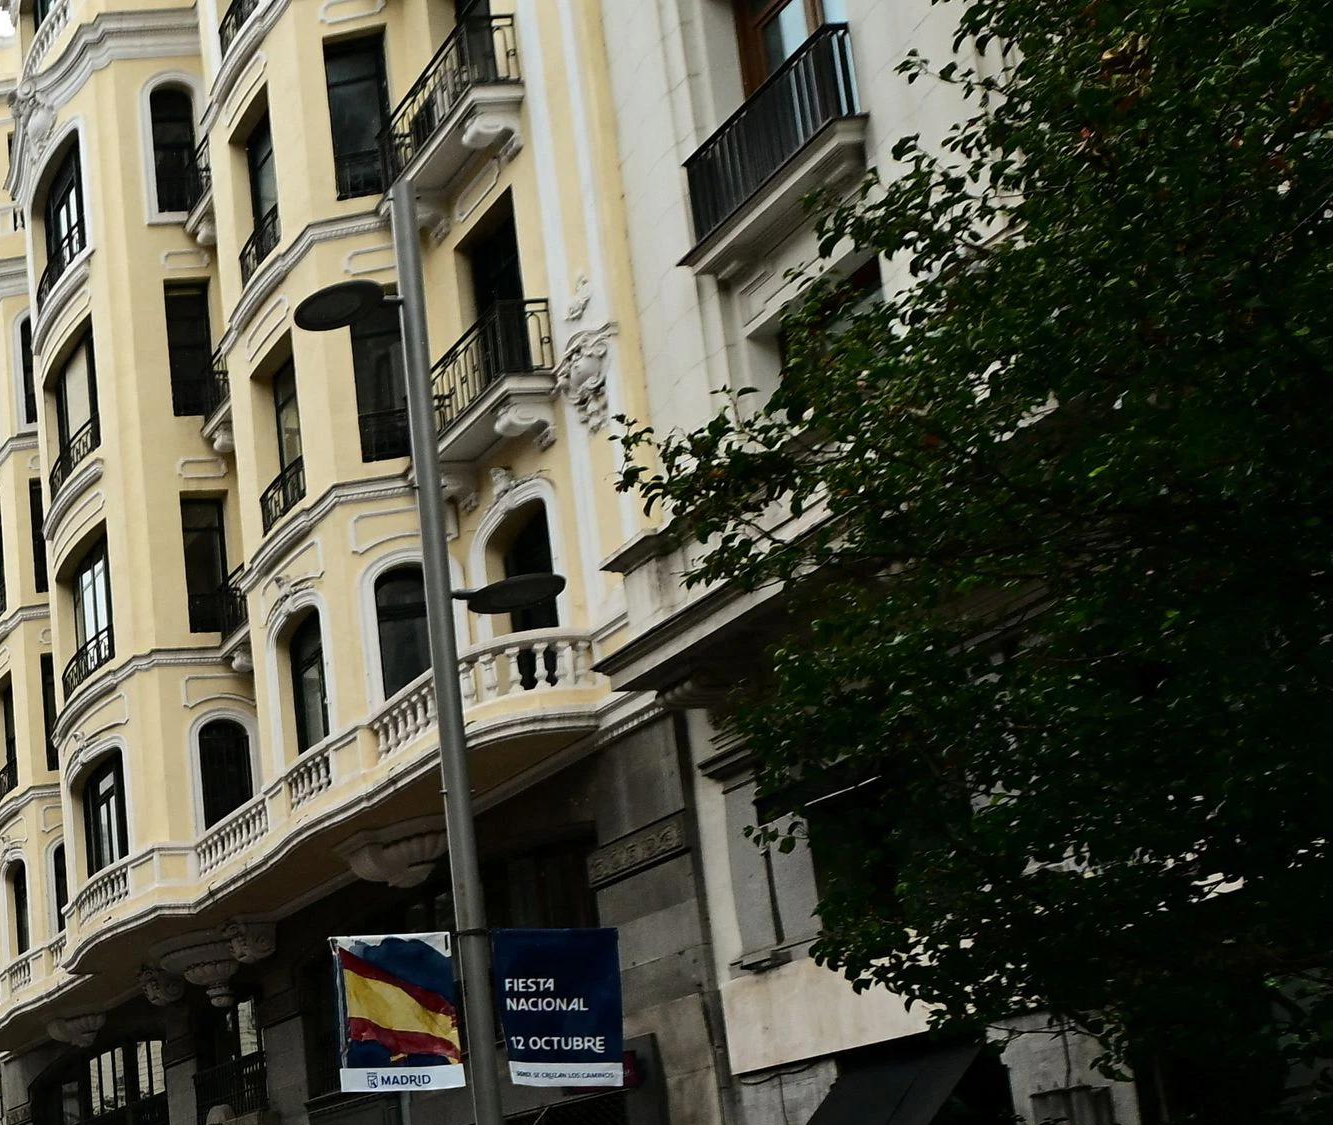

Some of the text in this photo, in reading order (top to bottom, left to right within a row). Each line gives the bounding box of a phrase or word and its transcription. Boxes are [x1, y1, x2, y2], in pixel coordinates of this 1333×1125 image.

[504, 978, 555, 992] FIESTA
[506, 997, 589, 1012] NACIONAL
[510, 1035, 606, 1053] 12 OCTUBRE
[381, 1073, 431, 1087] MADRID
